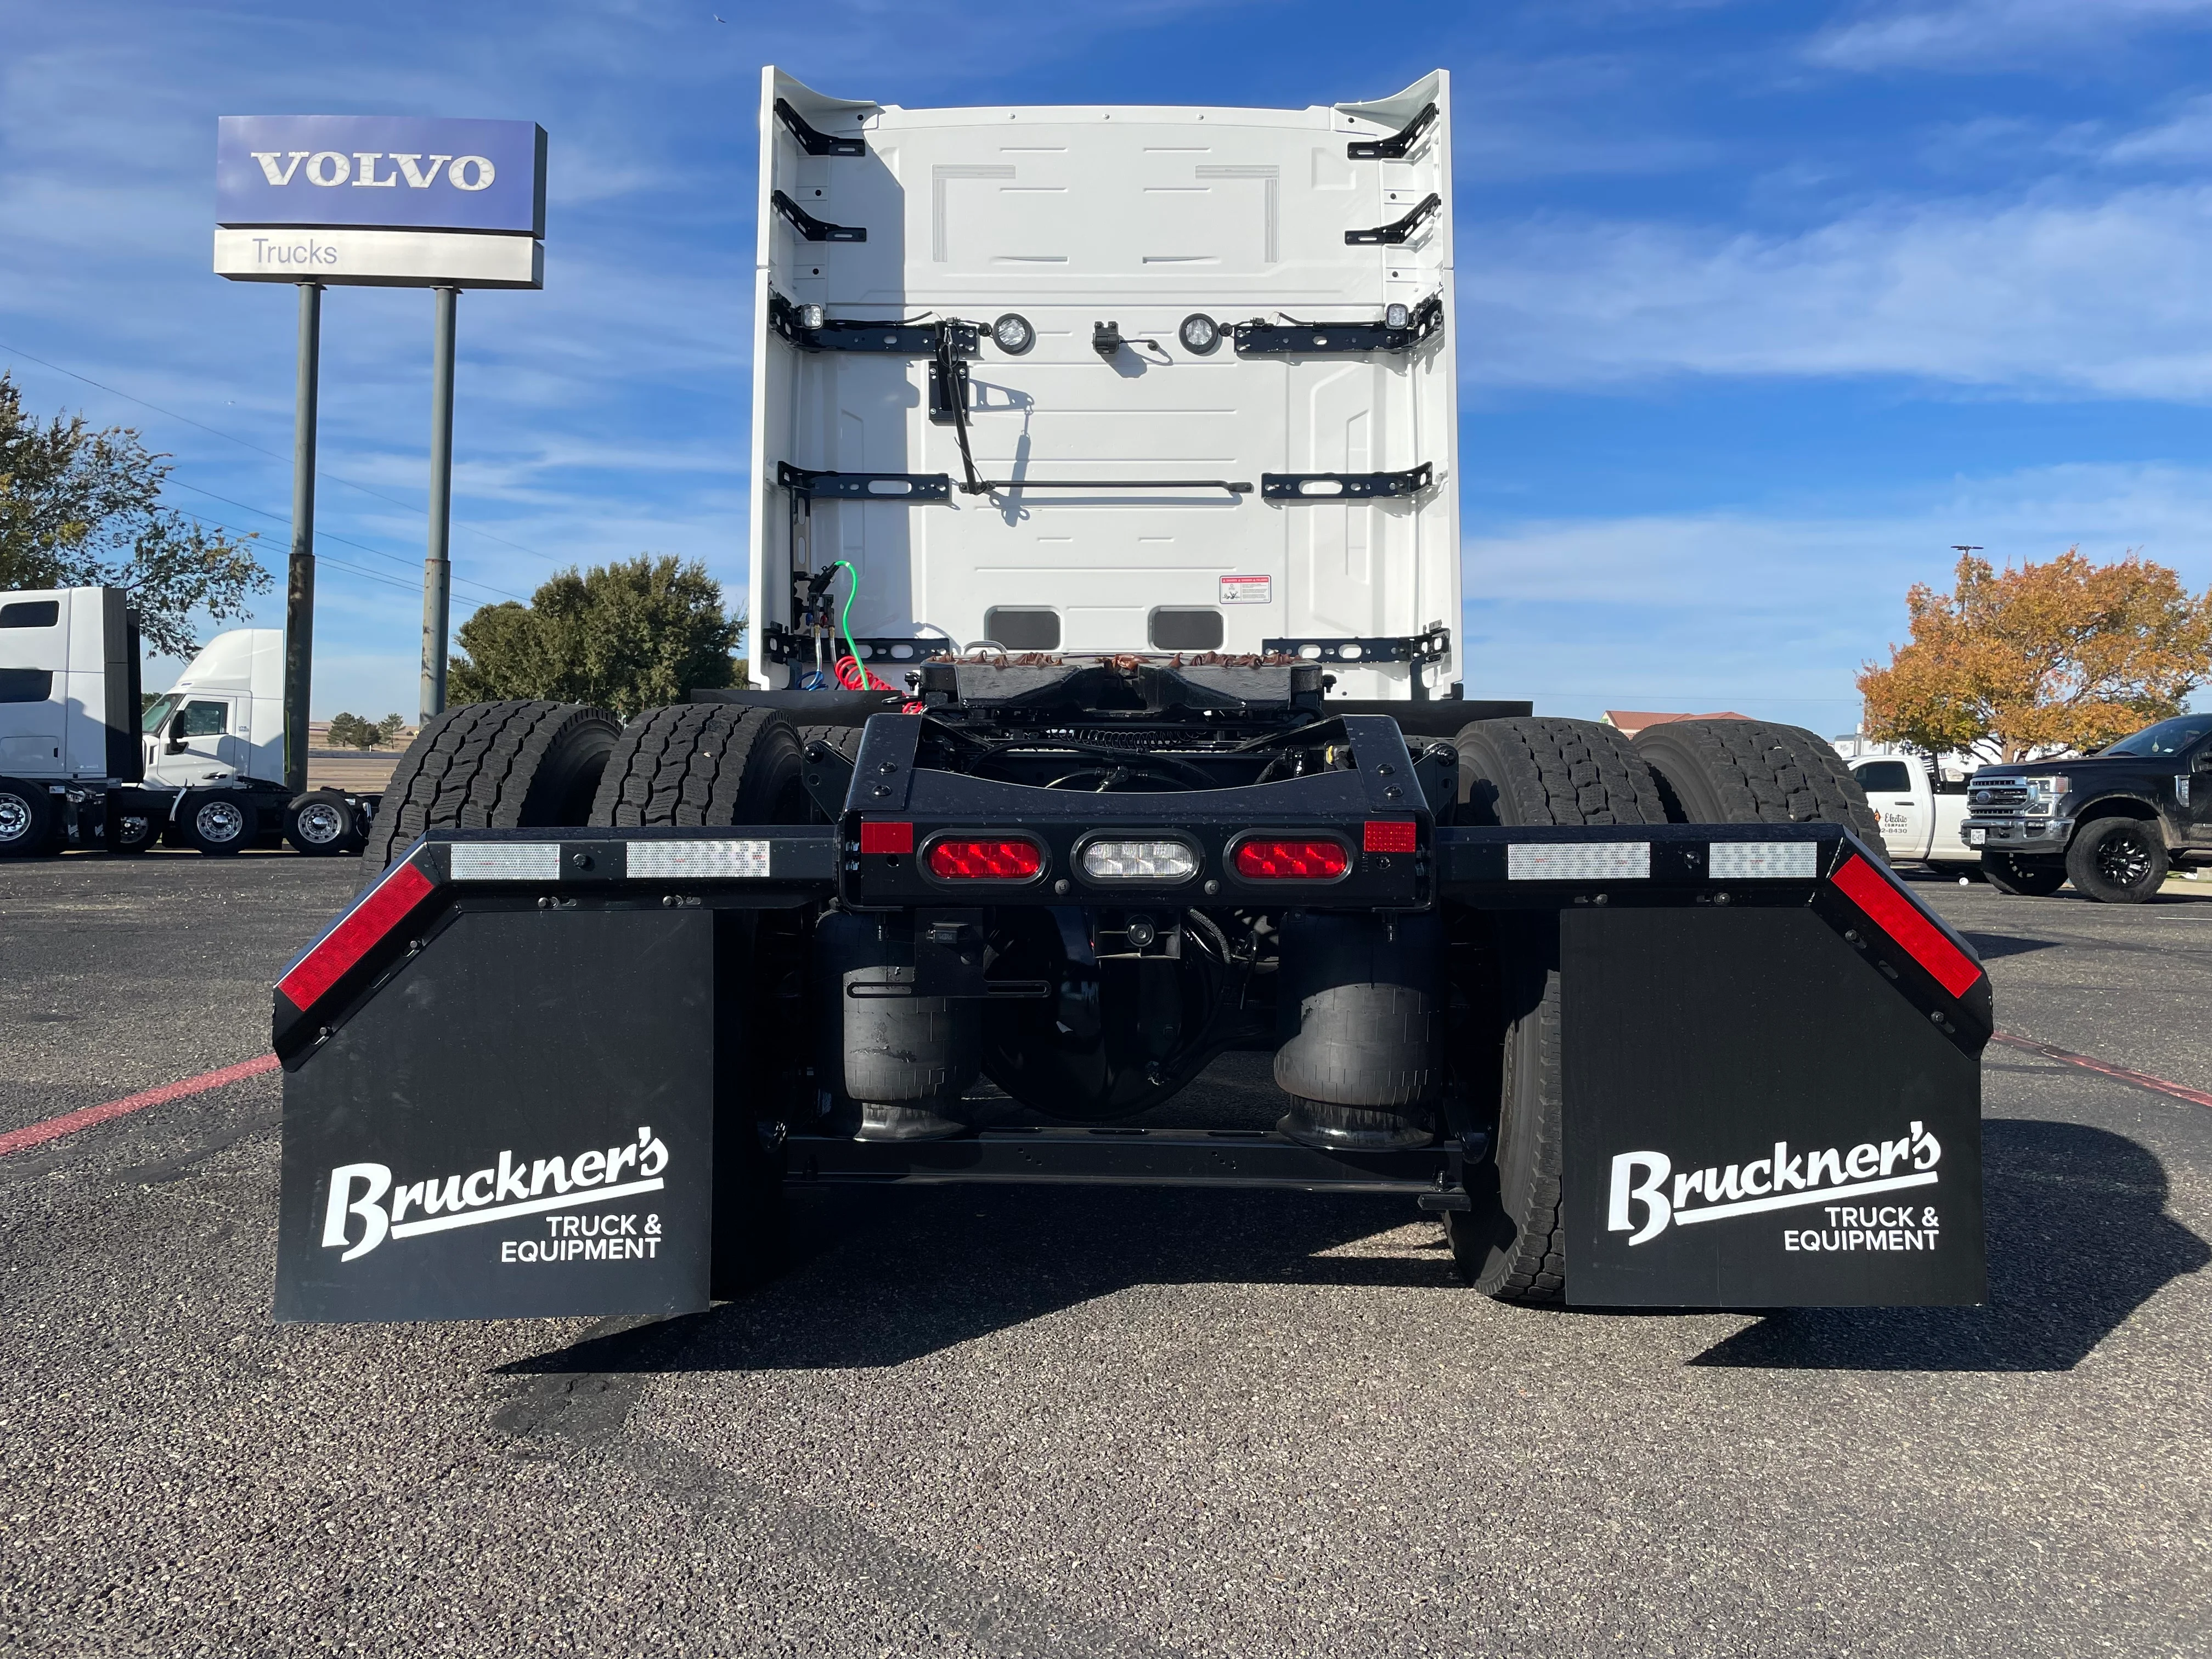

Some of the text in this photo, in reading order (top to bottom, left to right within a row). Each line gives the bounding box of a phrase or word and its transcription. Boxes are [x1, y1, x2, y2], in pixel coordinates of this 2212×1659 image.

[250, 151, 495, 191] VOLVO
[252, 238, 338, 264] Trucks
[1884, 812, 1908, 823] Electric
[321, 1125, 669, 1262] Bruckner's
[1607, 1120, 1941, 1247] Bruckner's
[545, 1213, 662, 1238] TRUCK &
[1824, 1206, 1939, 1228] TRUCK &
[500, 1237, 662, 1263] EQUIPMENT
[1784, 1229, 1939, 1251] EQUIPMENT
